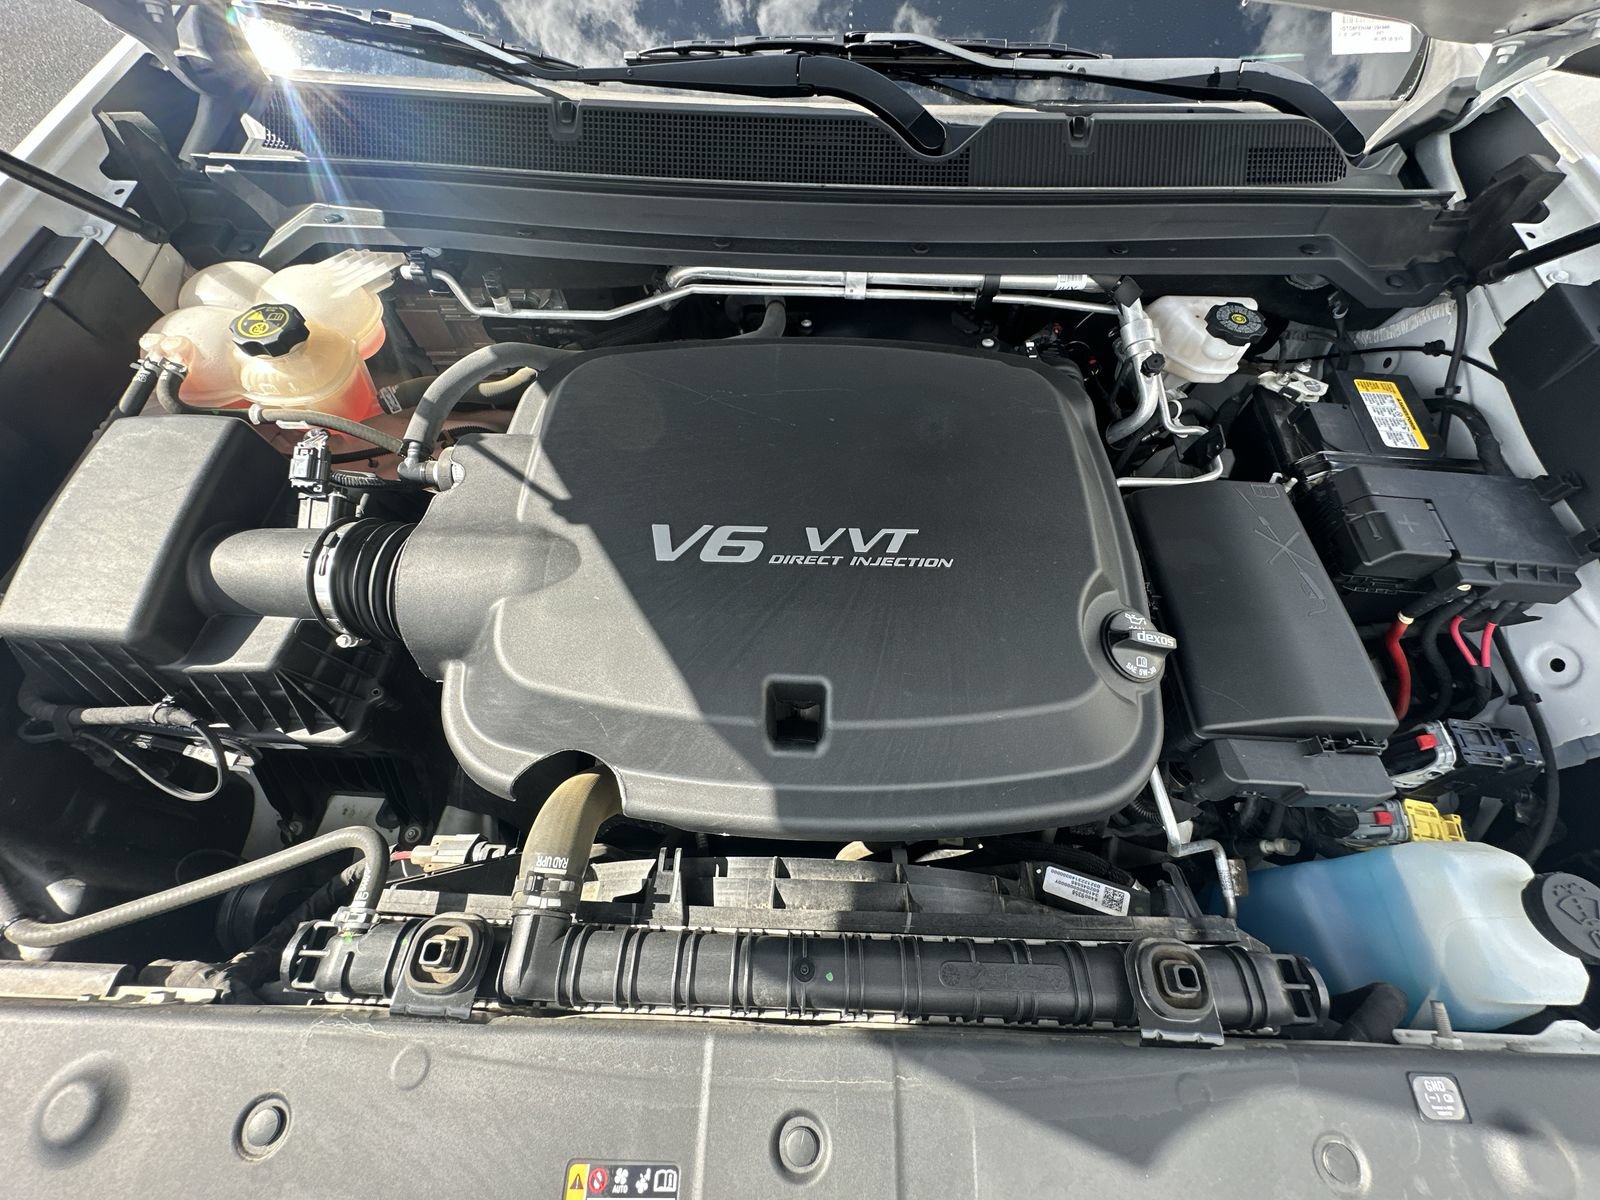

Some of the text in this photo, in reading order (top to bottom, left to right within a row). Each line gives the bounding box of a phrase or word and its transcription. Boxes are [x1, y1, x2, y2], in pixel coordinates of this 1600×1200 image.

[651, 523, 768, 563] V6
[805, 527, 920, 553] VVT
[768, 554, 954, 568] DIRECT INJECTION
[1136, 631, 1174, 647] dexos
[1125, 662, 1157, 676] SAE 5W-30
[536, 855, 569, 869] RAD UPR
[1424, 1079, 1446, 1092] GND
[612, 1184, 628, 1194] AUTO
